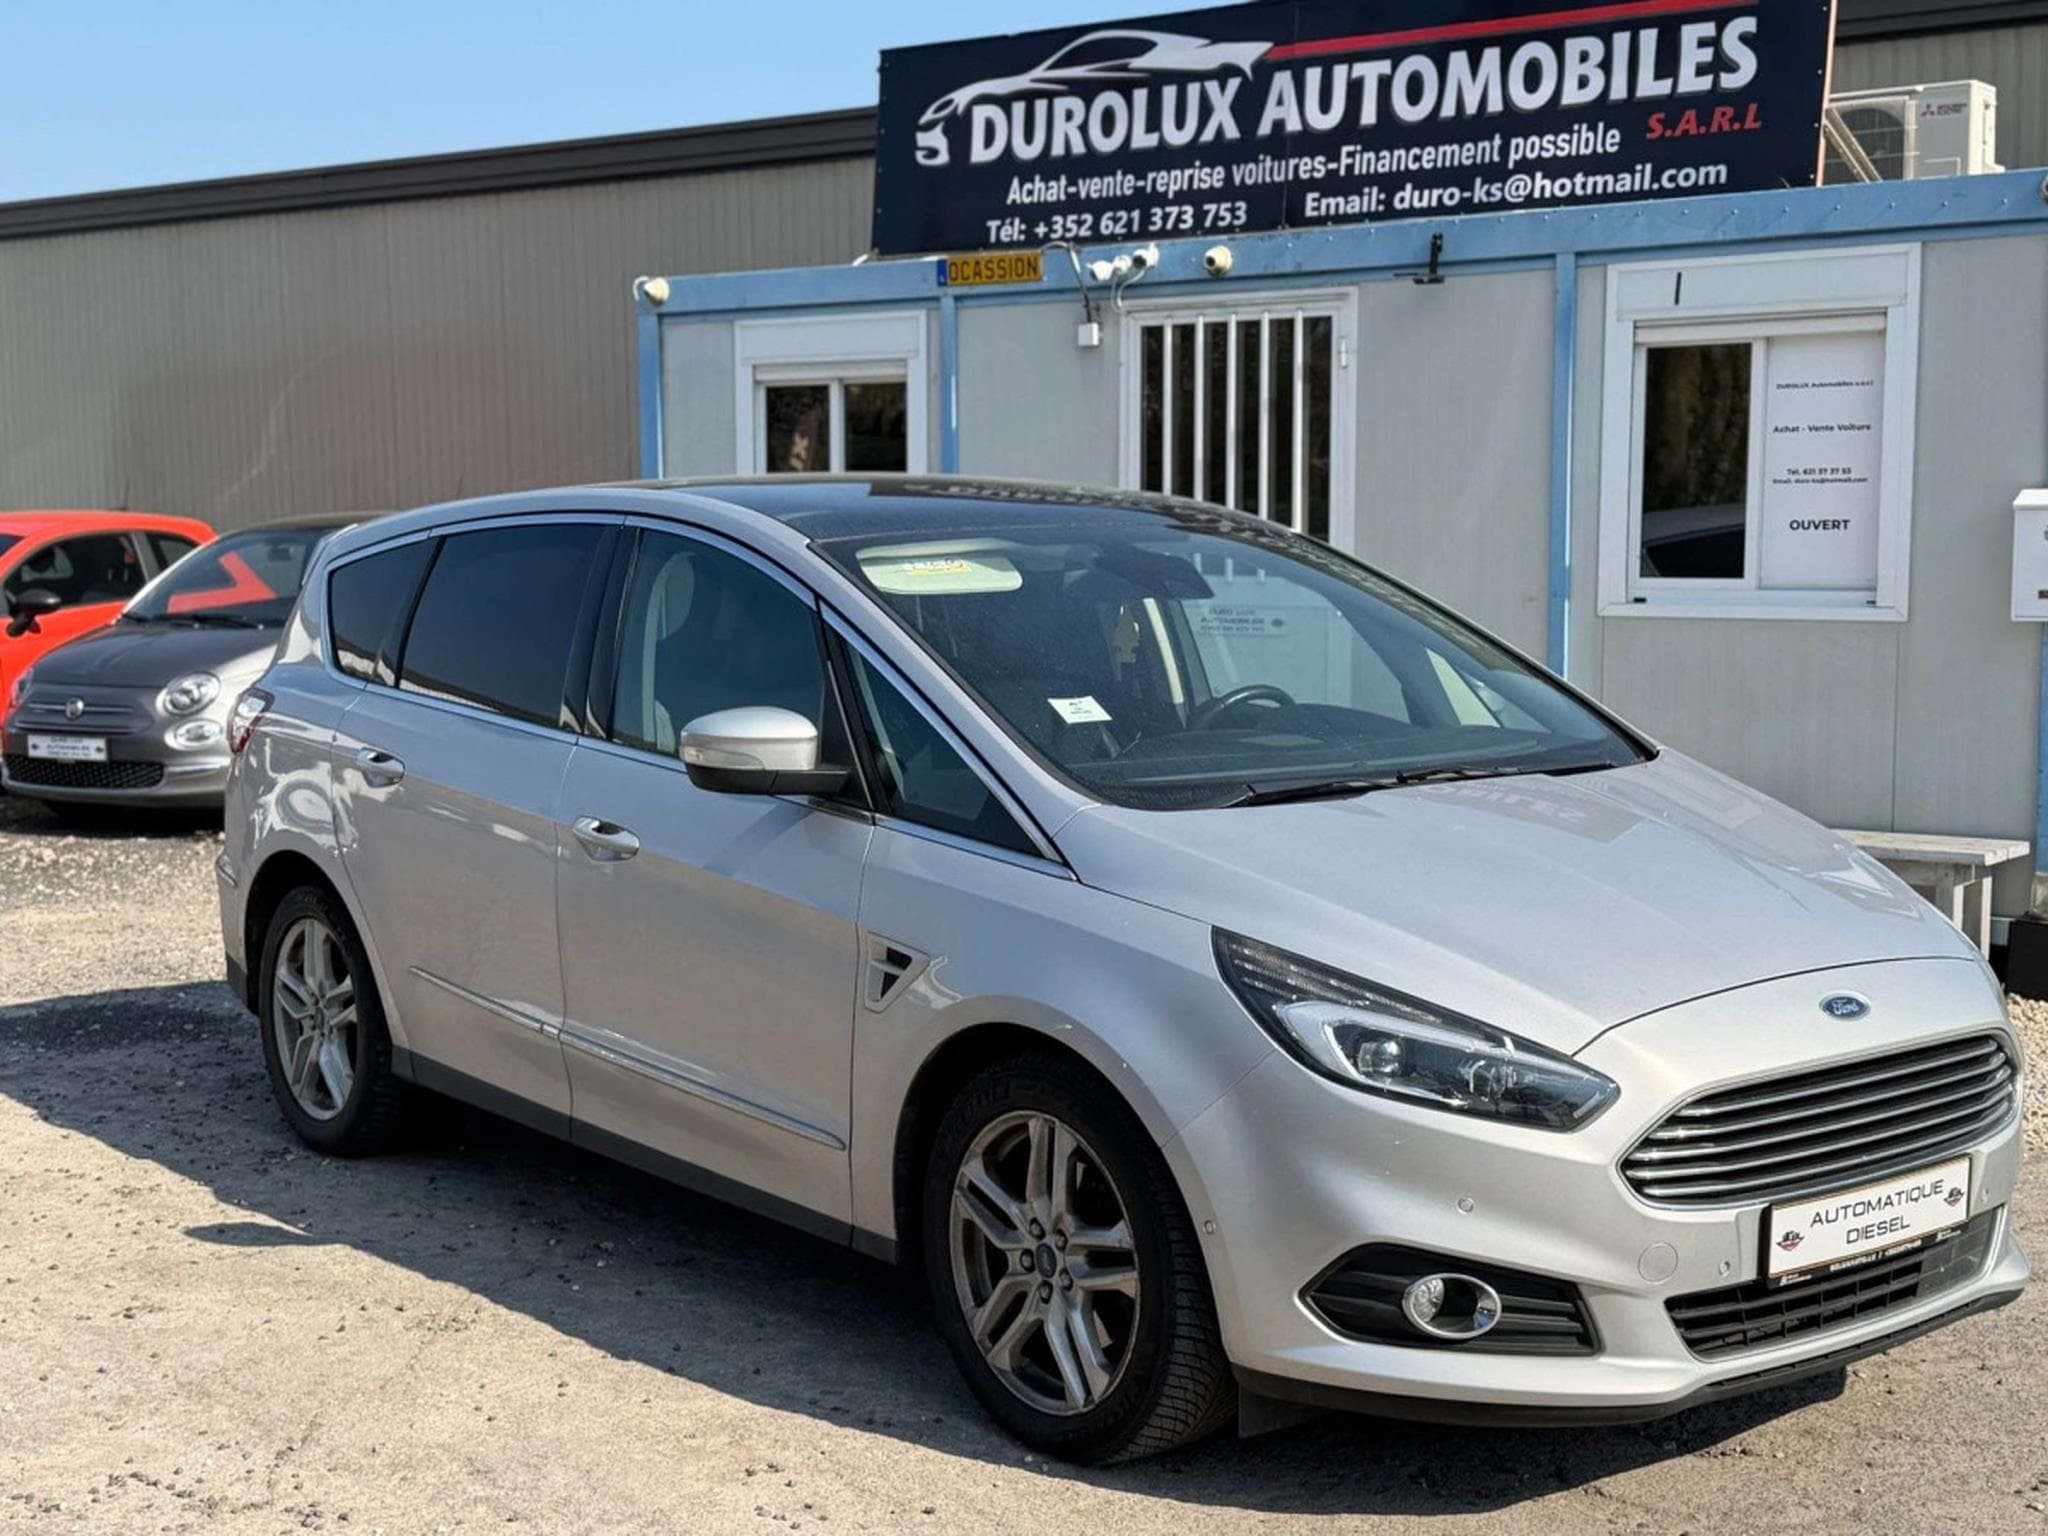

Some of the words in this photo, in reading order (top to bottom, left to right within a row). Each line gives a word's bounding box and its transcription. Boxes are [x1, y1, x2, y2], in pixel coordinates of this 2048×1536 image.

[969, 77, 1241, 164] DUROLUX
[1257, 16, 1758, 136] AUTOMOBILES
[1645, 103, 1762, 140] S.A.R.L
[1007, 164, 1225, 205] Achat-vente-reprise
[1231, 134, 1500, 186] voitures-Financement
[1508, 122, 1621, 168] possible
[1304, 188, 1386, 218] Email:
[1393, 162, 1728, 211] duro-ks@hotmail.com
[986, 217, 1027, 244] Tél:
[1033, 211, 1093, 239] +352
[1100, 209, 1140, 236] 621
[1148, 206, 1195, 233] 373
[1202, 201, 1248, 229] 753
[948, 257, 1039, 282] OCASSION
[1773, 425, 1800, 433] Achat
[1807, 424, 1834, 432] Vente
[1789, 519, 1851, 531] OUVERT
[1832, 999, 1860, 1015] Ford
[1810, 1179, 1944, 1228] AUTOMATIQUE
[1846, 1215, 1911, 1244] DIESEL
